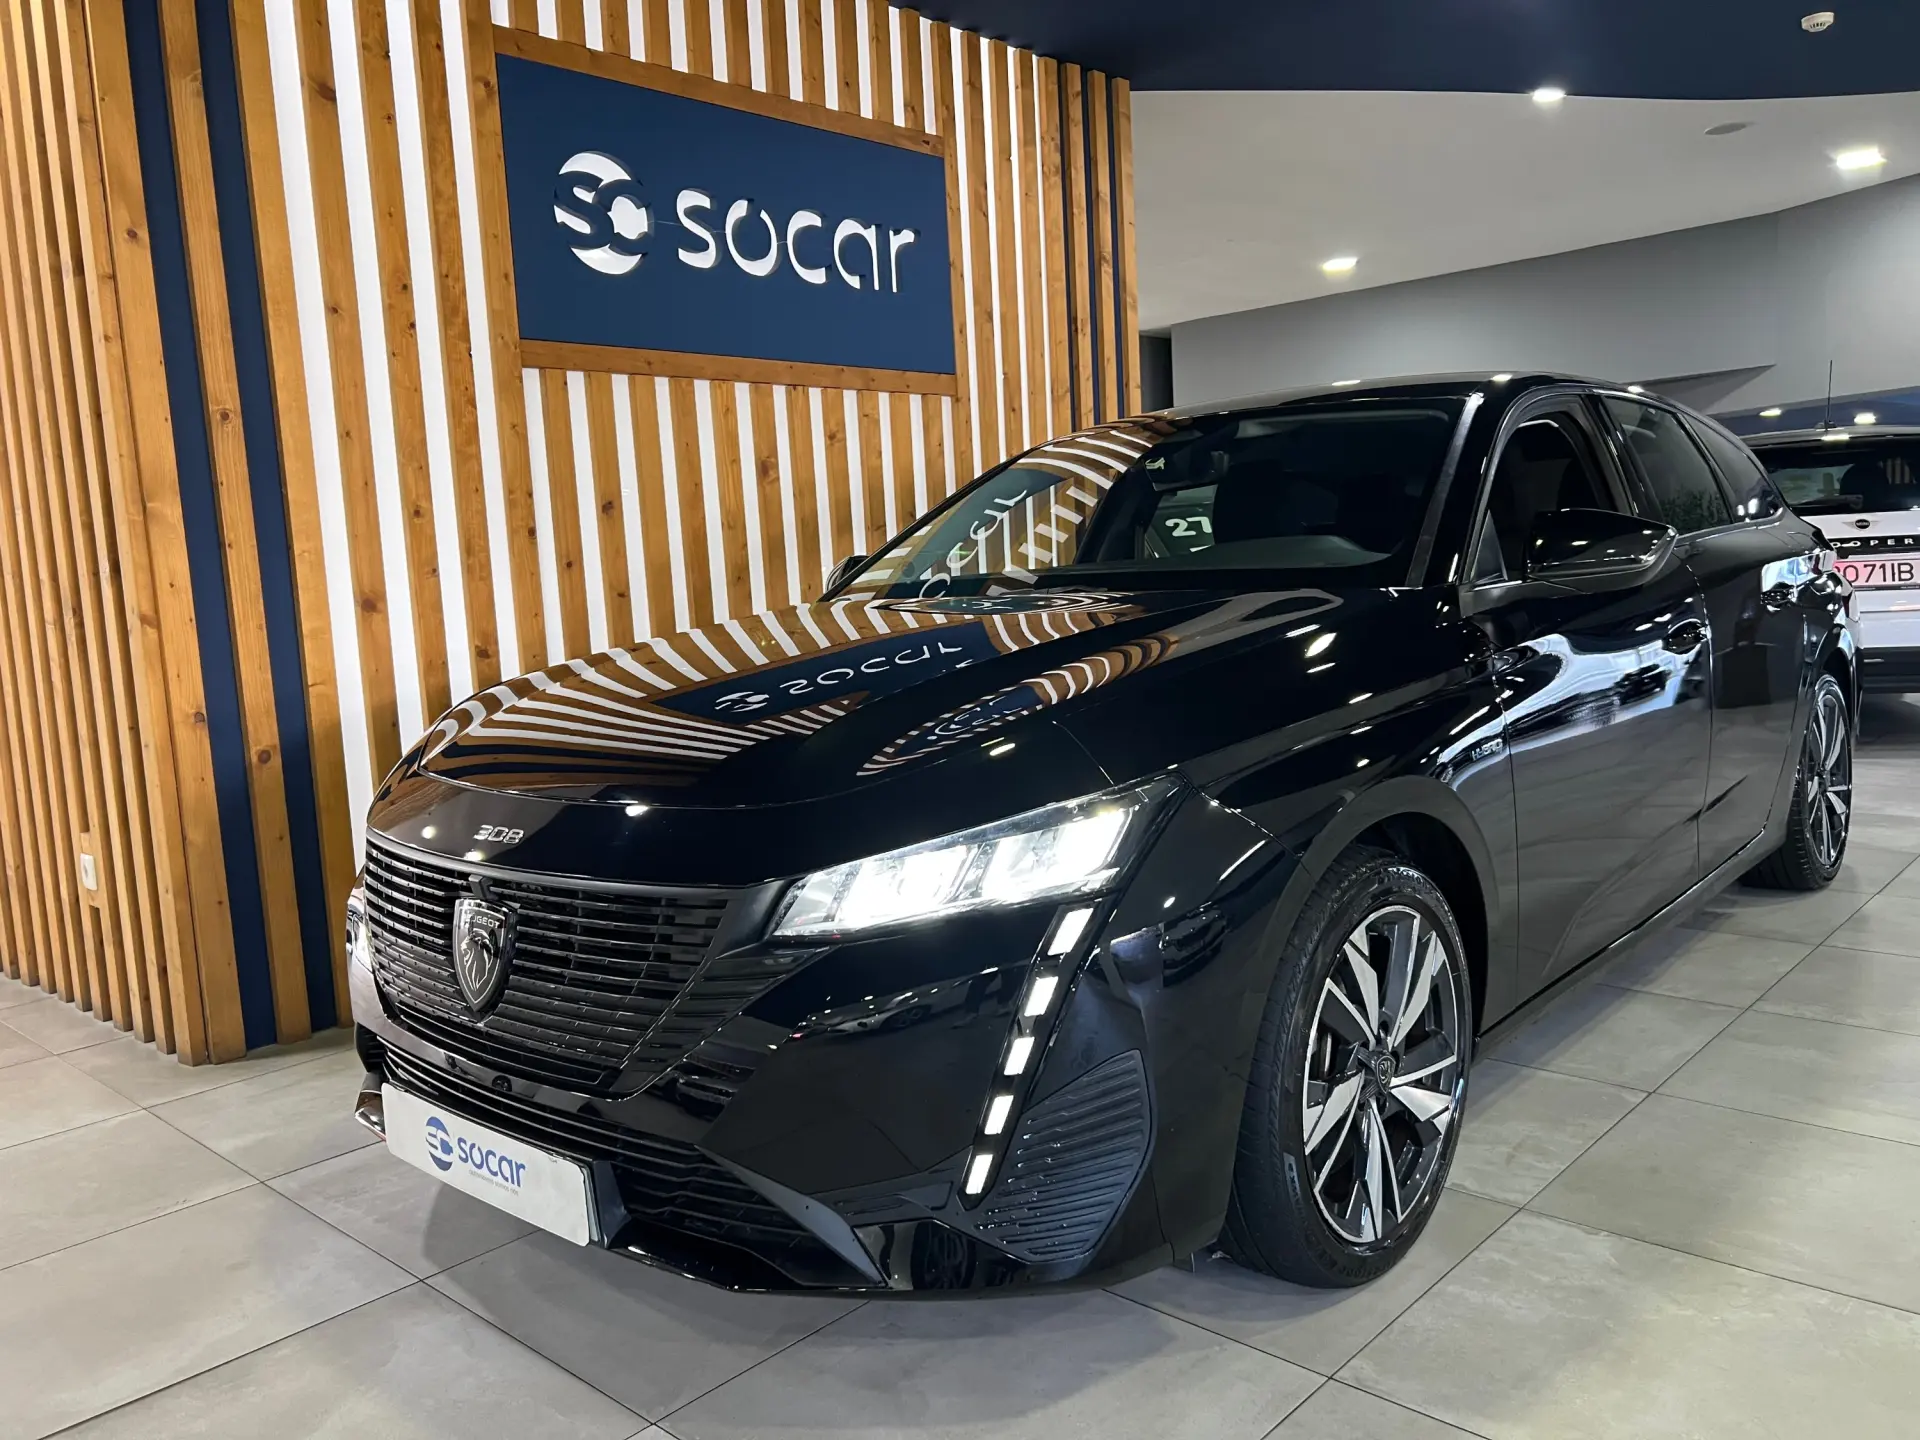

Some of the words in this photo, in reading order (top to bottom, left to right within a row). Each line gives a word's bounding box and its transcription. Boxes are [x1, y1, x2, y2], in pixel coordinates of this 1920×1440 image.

[675, 187, 918, 294] socar
[1831, 537, 1914, 548] OOPER
[473, 824, 524, 844] 308
[464, 910, 500, 929] UGEOT
[456, 1136, 526, 1188] socar
